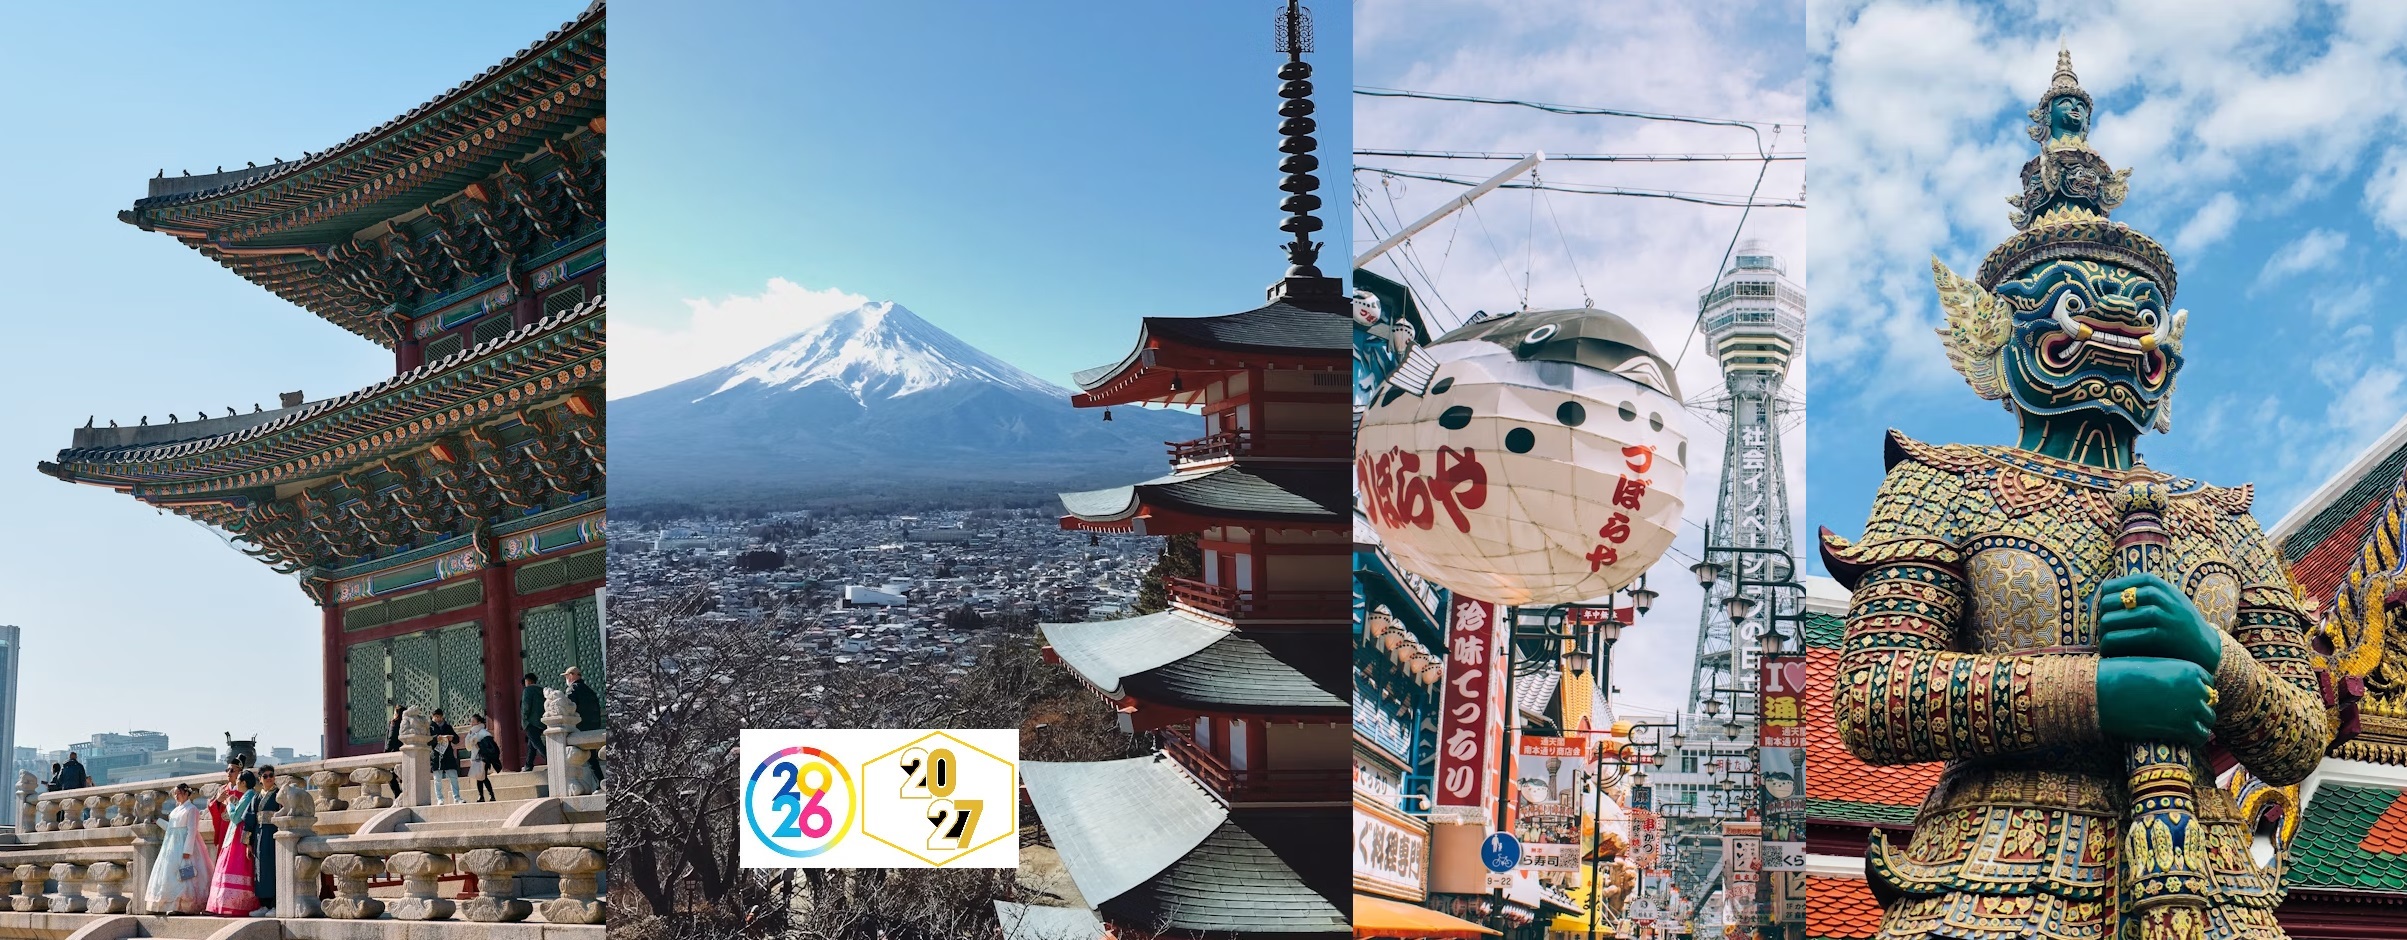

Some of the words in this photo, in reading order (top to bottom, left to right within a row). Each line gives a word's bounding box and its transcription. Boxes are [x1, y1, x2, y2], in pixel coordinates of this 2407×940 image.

[1357, 445, 1488, 533] づぼらや
[1586, 444, 1657, 573] づぼらや
[1765, 662, 1784, 692] I
[1353, 820, 1422, 881] ぐ料理専門
[1643, 817, 1655, 852] 串かつ
[1783, 855, 1805, 867] くら
